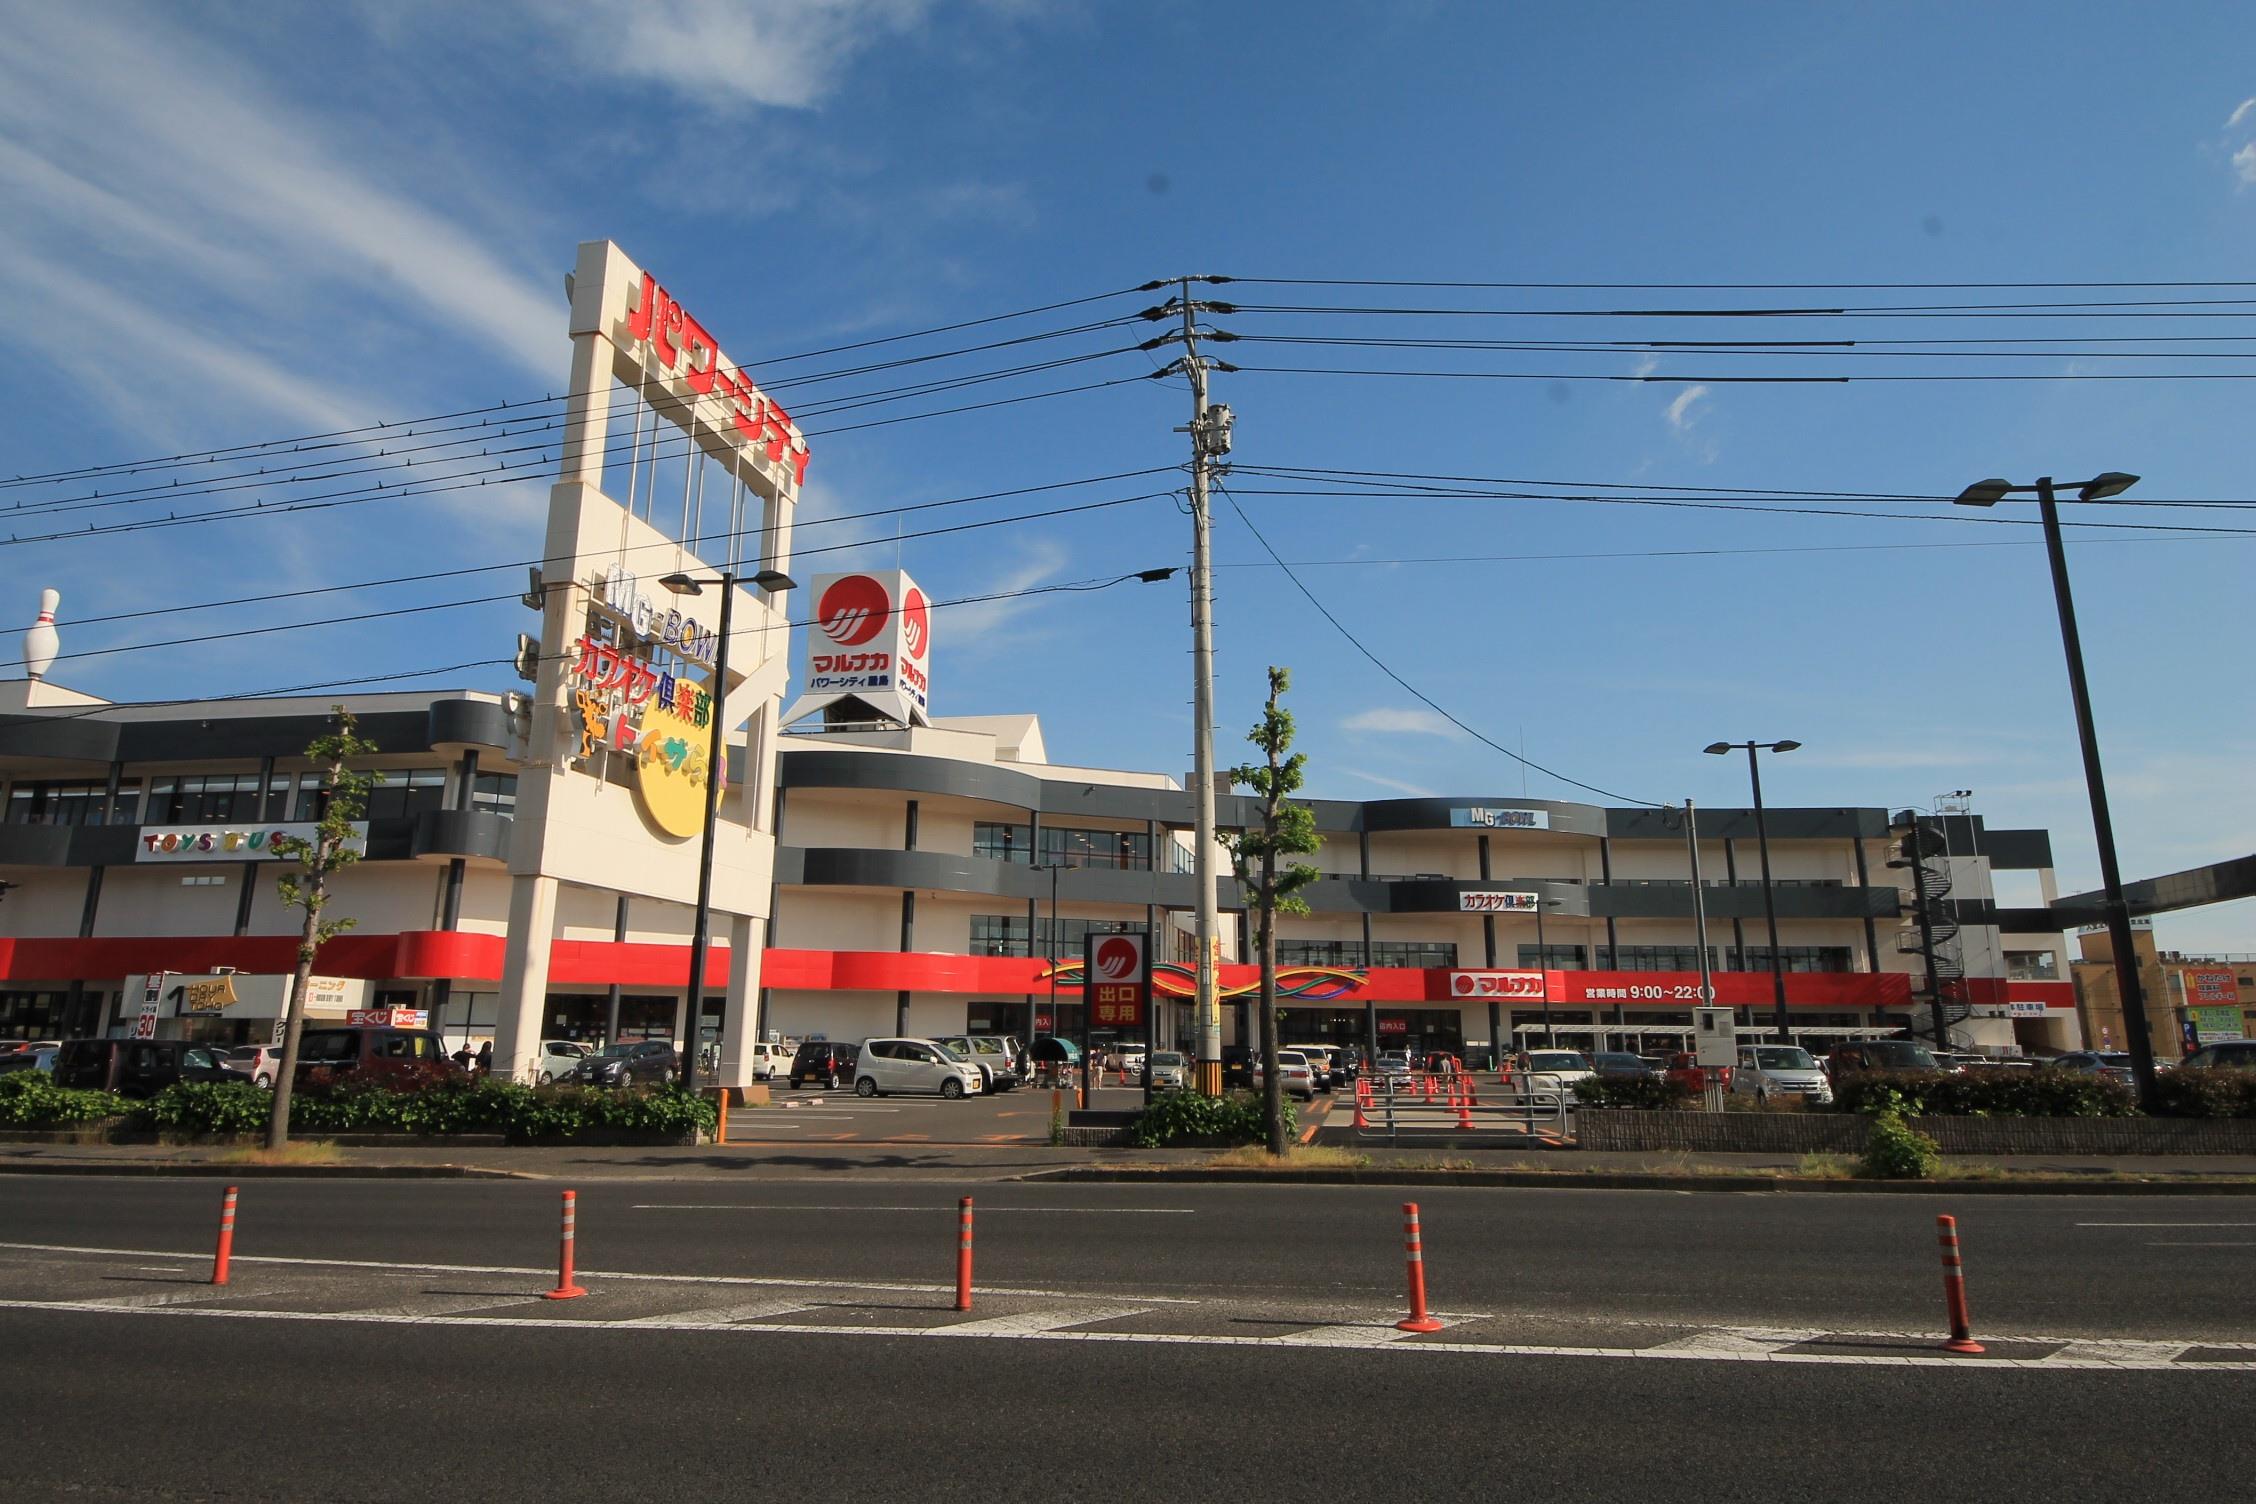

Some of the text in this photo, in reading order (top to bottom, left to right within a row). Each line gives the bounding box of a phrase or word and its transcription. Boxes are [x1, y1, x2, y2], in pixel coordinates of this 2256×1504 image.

[627, 271, 810, 487] パワーシティ
[605, 561, 718, 665] MG-BOW
[812, 652, 889, 673] マルナカ
[573, 633, 712, 730] カラオケ倶楽部
[811, 676, 866, 688] パワーシティ
[1471, 807, 1537, 829] MG-BOWL
[143, 833, 214, 853] TOYS
[1464, 894, 1536, 911] カラオケ倶楽部
[191, 984, 226, 994] HOUR
[1100, 986, 1135, 1002] 出口
[1479, 977, 1544, 995] マルナカ
[1585, 988, 1627, 999] 営業時間
[167, 985, 184, 1017] 1
[351, 1011, 388, 1025] 宝くじ
[1099, 1005, 1135, 1021] 専用
